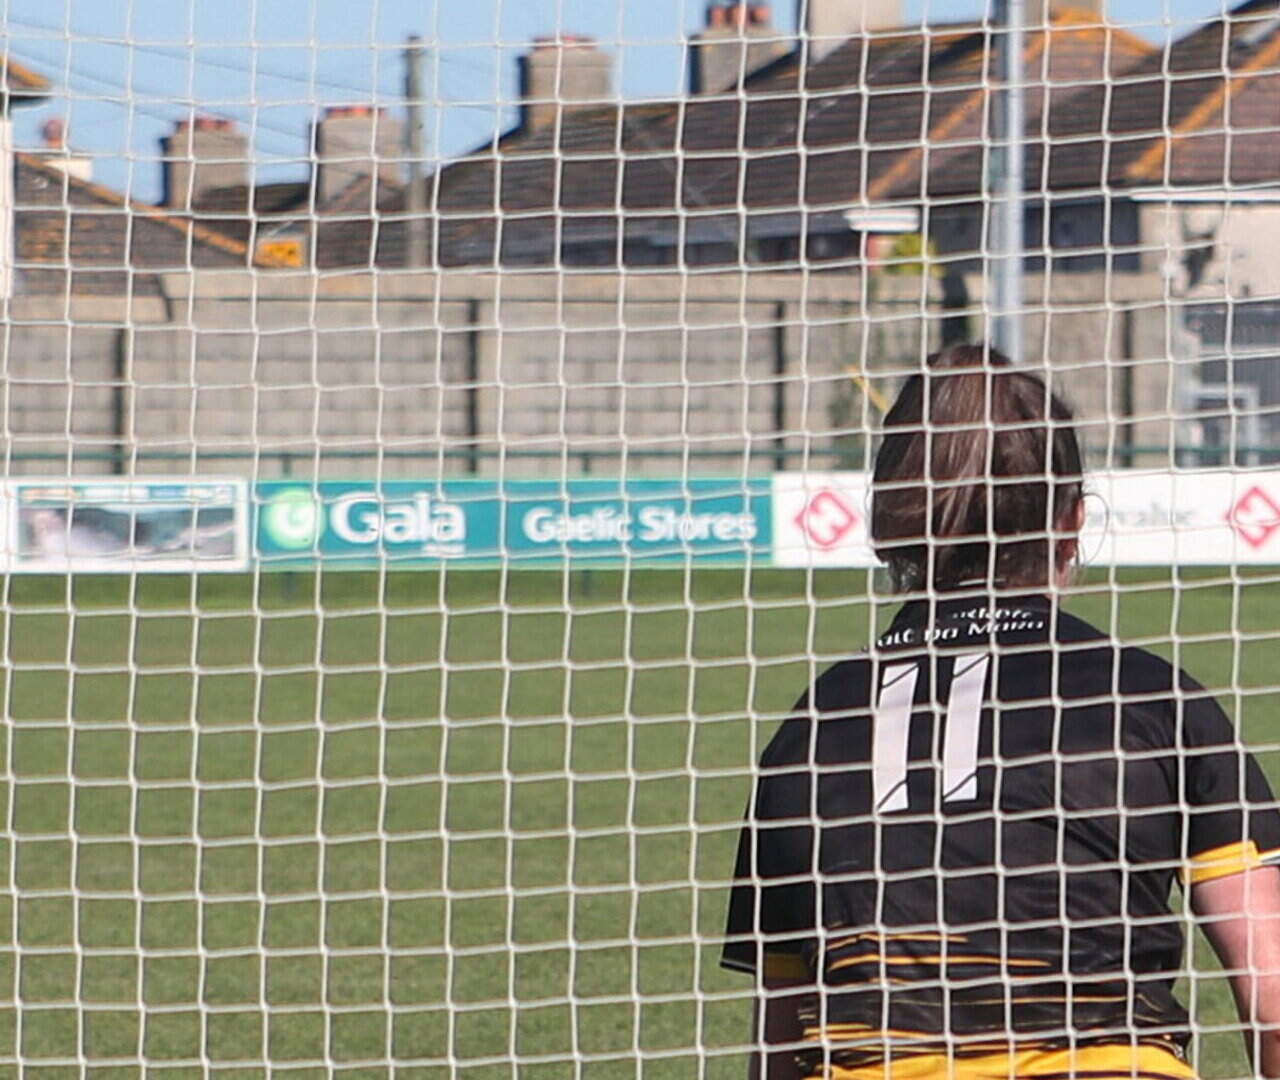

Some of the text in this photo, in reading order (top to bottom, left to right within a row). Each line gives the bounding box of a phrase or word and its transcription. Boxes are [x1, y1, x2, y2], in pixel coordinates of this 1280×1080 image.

[329, 491, 465, 544] Gala
[522, 505, 758, 543] Gaelic Stores
[873, 653, 990, 813] 11
